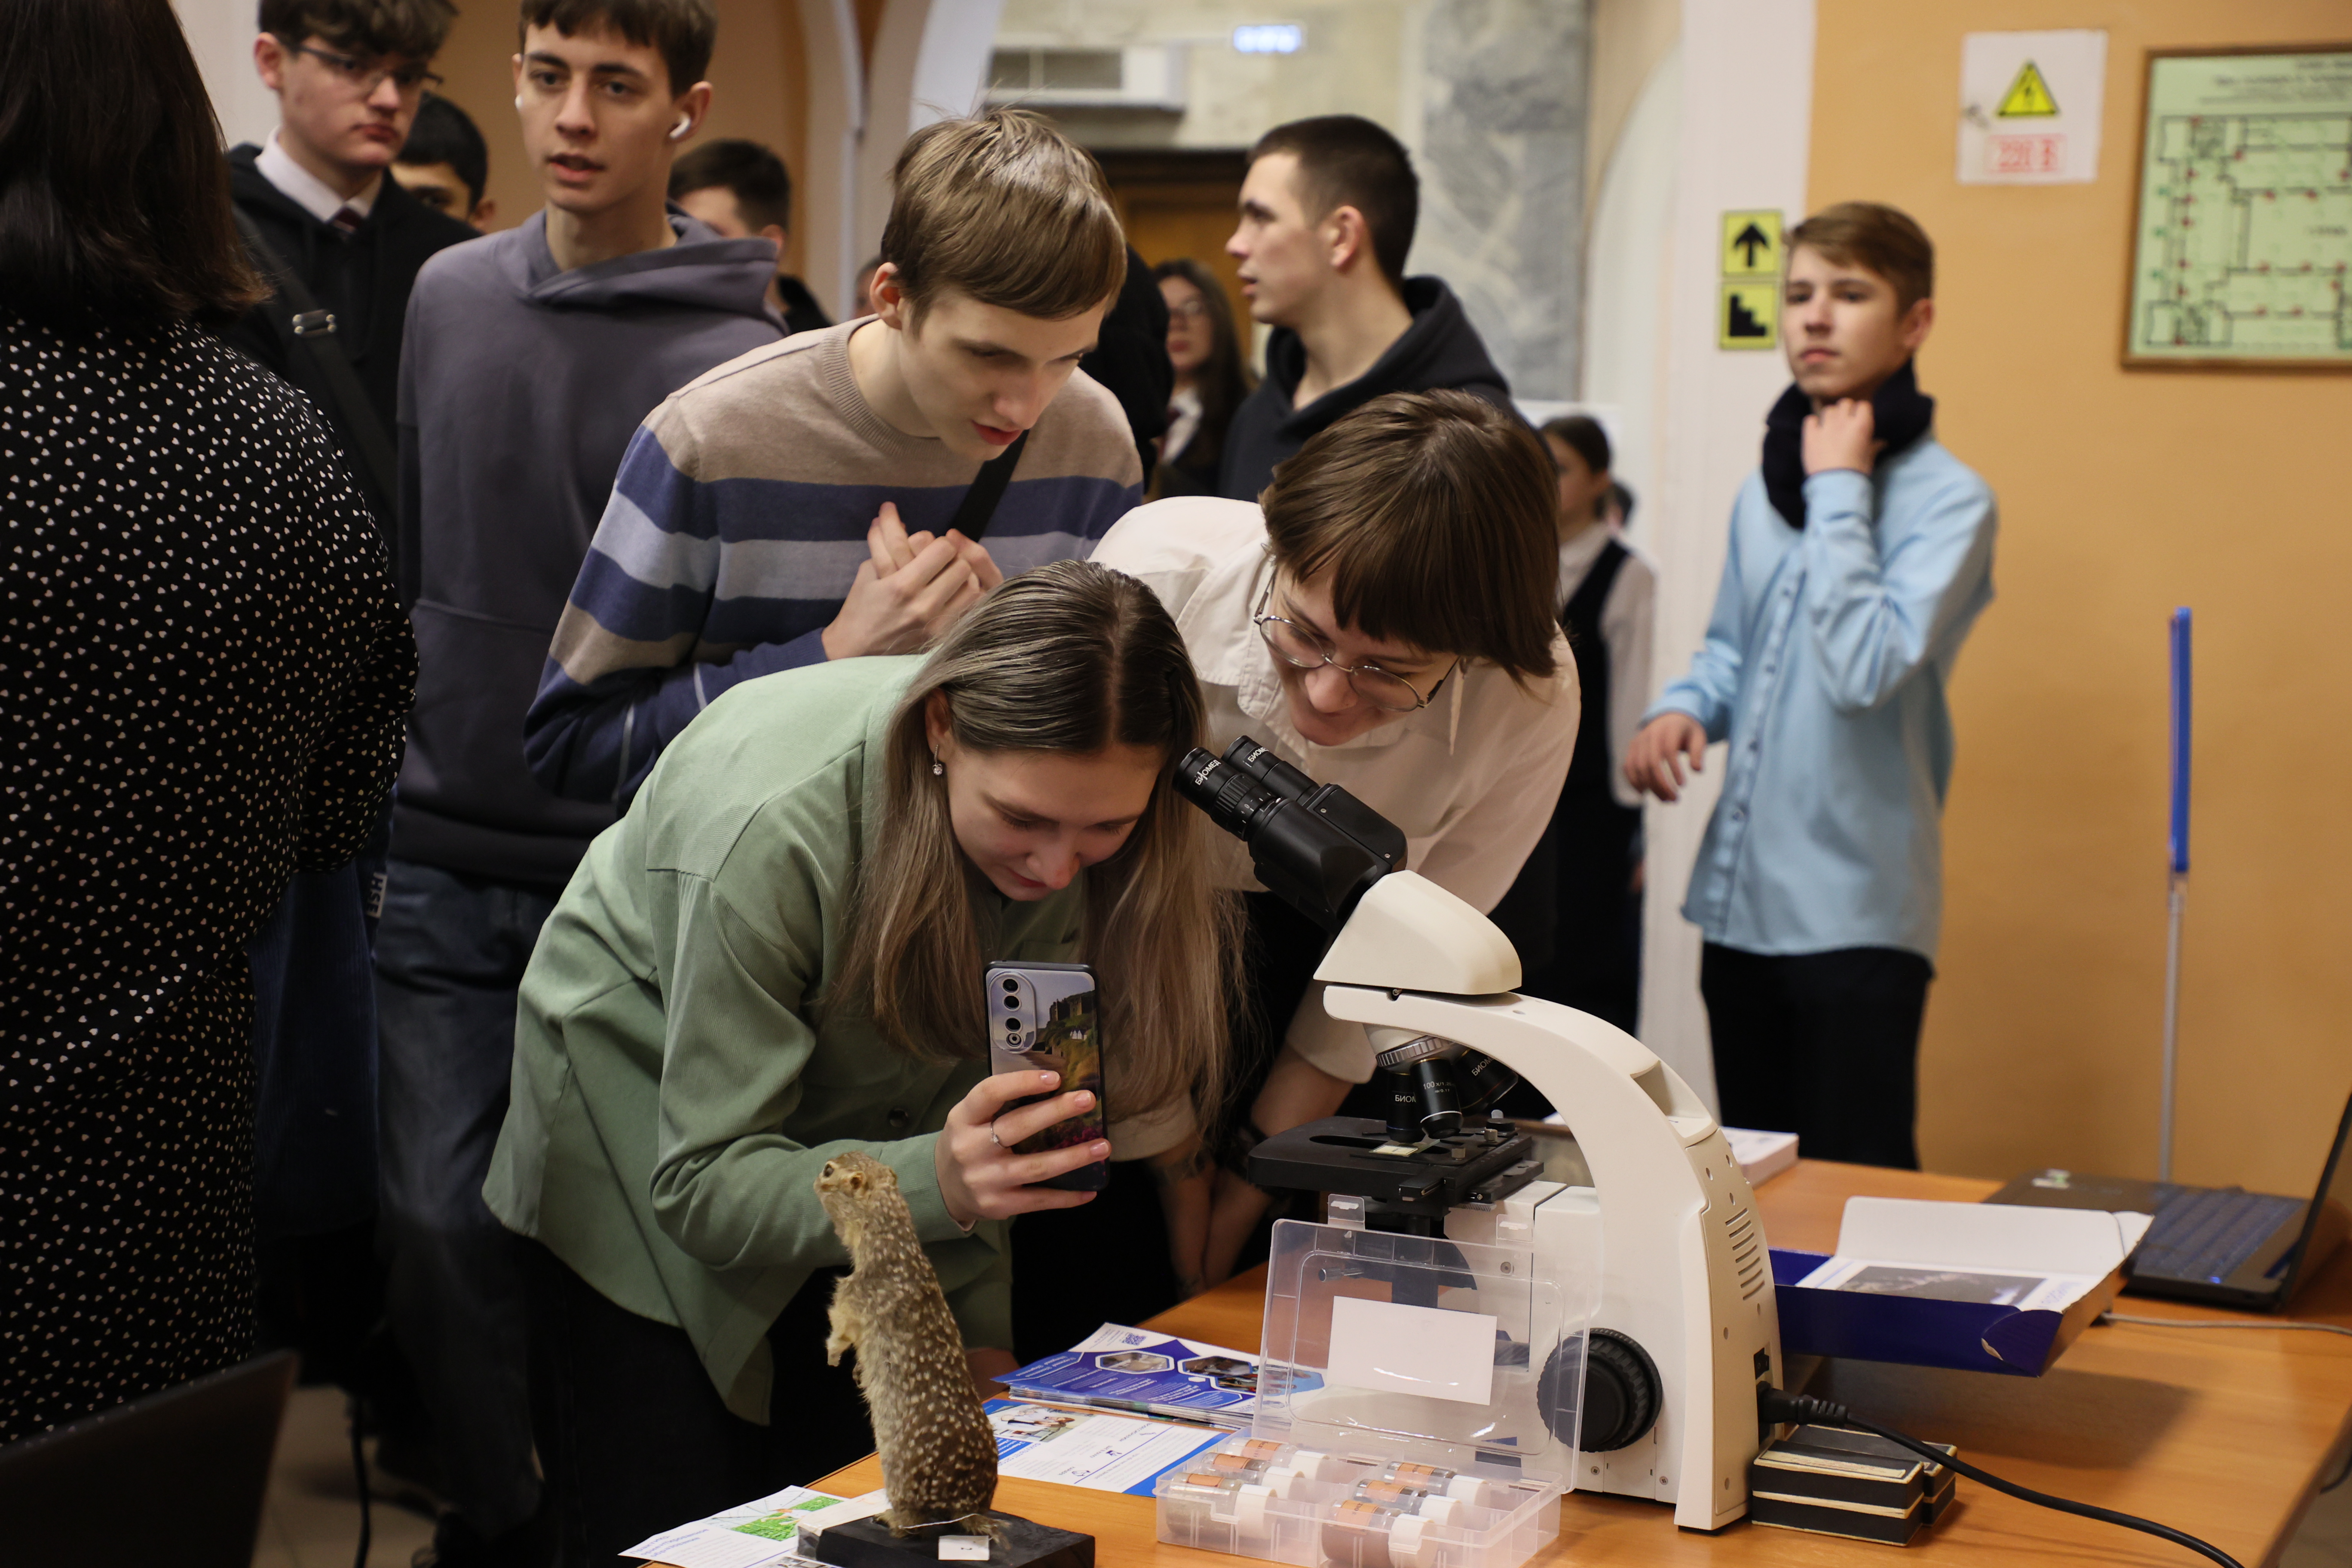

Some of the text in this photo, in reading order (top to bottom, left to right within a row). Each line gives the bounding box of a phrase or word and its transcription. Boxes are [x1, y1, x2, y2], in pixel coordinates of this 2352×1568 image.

[1195, 760, 1221, 785] БИОМЕД
[1471, 1057, 1494, 1076] БИОМ
[630, 1535, 670, 1554] Практико-
[641, 1529, 710, 1556] ориентированное
[650, 1537, 701, 1558] образование
